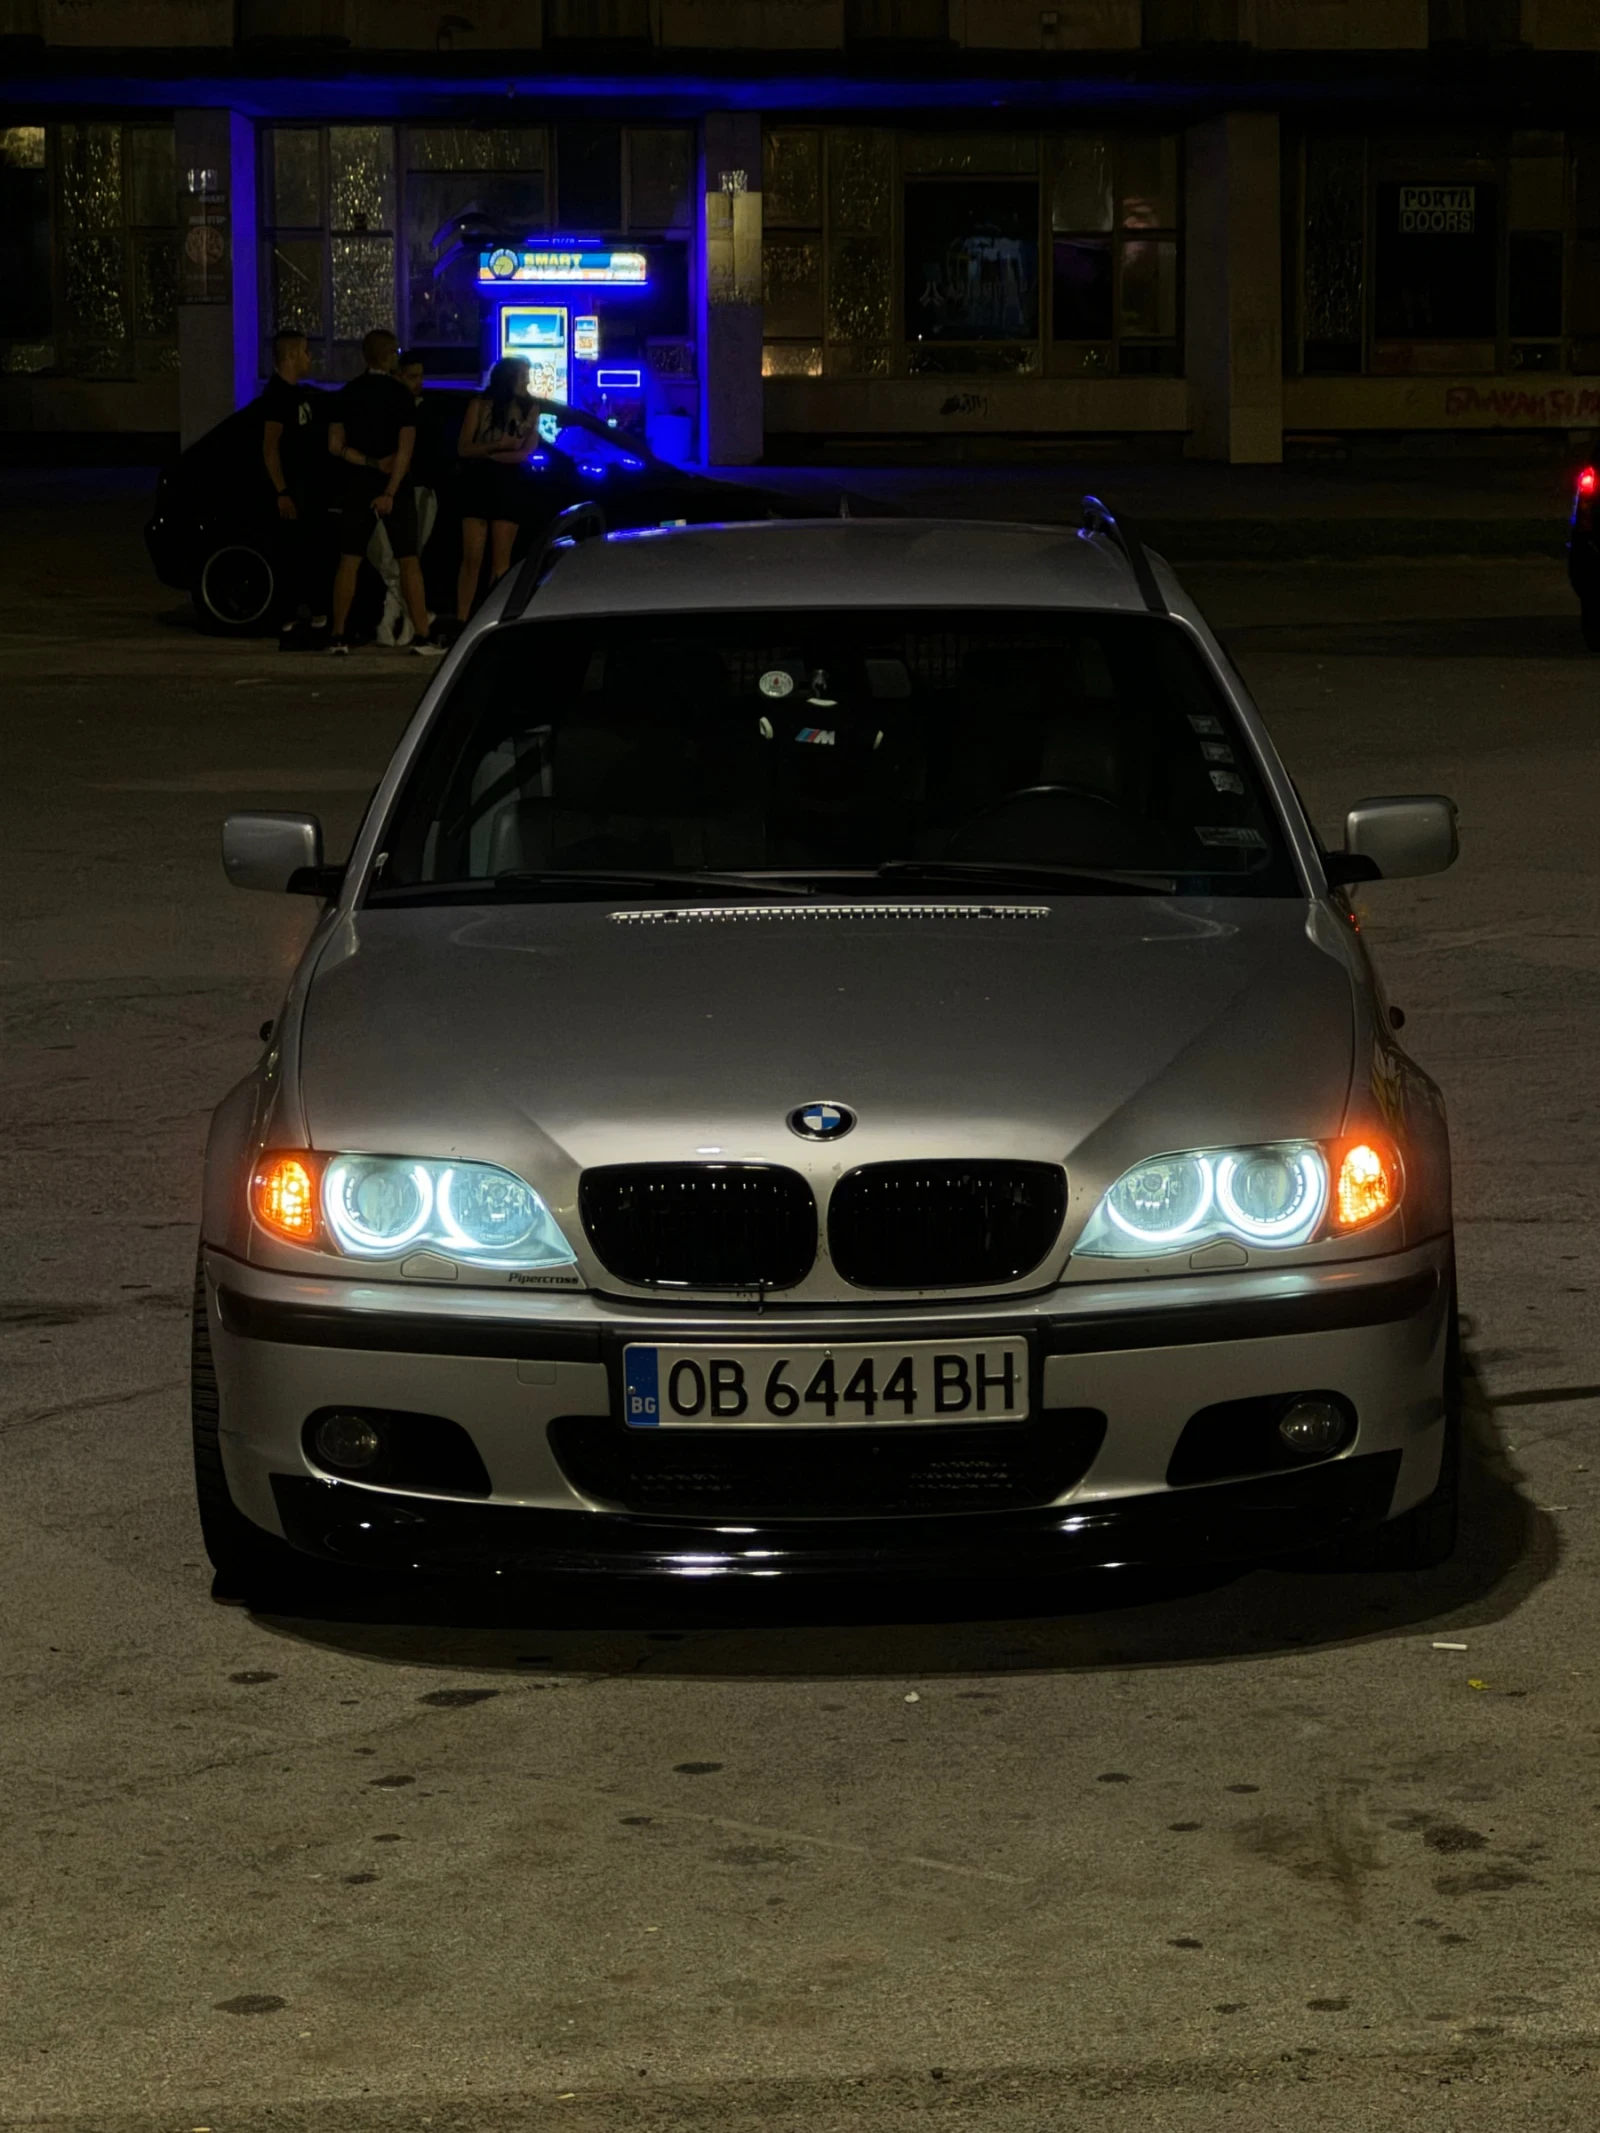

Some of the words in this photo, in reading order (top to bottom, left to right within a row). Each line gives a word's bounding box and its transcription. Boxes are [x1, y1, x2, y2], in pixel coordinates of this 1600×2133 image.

[1404, 190, 1472, 208] PORTA
[1402, 211, 1472, 232] DOORS
[524, 253, 582, 266] SMART
[508, 1272, 579, 1285] Pipercross
[669, 1359, 748, 1416] OB
[765, 1357, 917, 1416] 6444
[933, 1352, 1013, 1412] BH
[631, 1396, 656, 1414] BG
